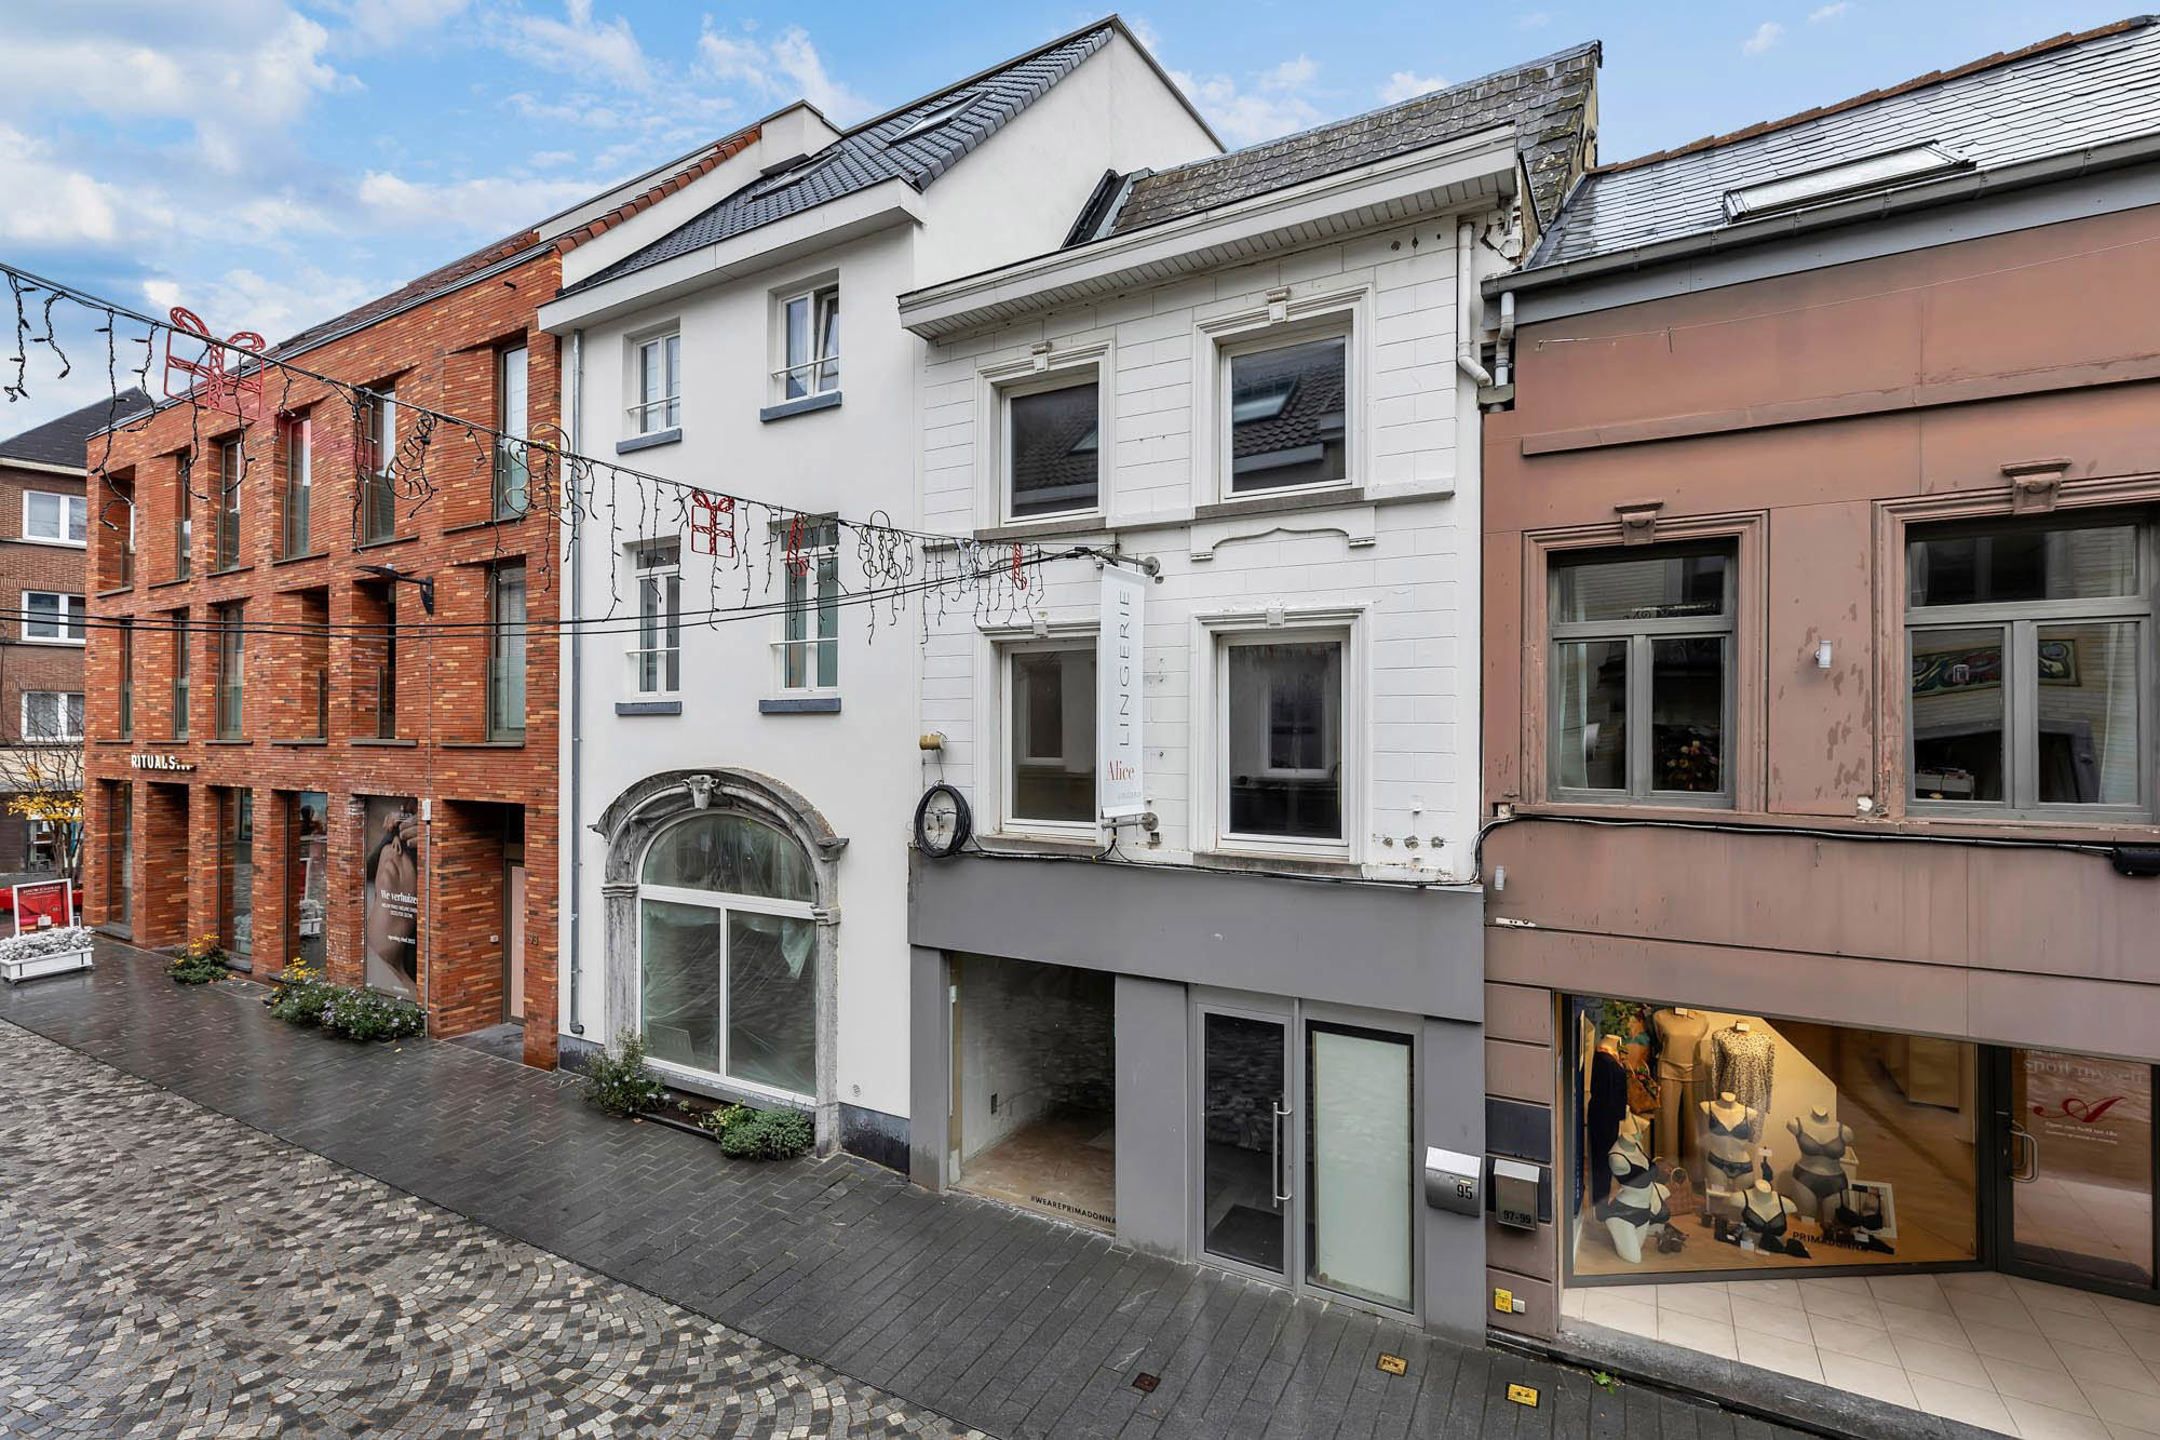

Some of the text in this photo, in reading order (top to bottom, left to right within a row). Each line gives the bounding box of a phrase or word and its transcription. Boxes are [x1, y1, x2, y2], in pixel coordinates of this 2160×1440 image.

[1119, 588, 1130, 746] LINGERIE
[1106, 759, 1135, 782] Alice
[391, 892, 418, 904] verhuize
[1456, 1184, 1473, 1200] 95
[1503, 1210, 1531, 1225] 97-99
